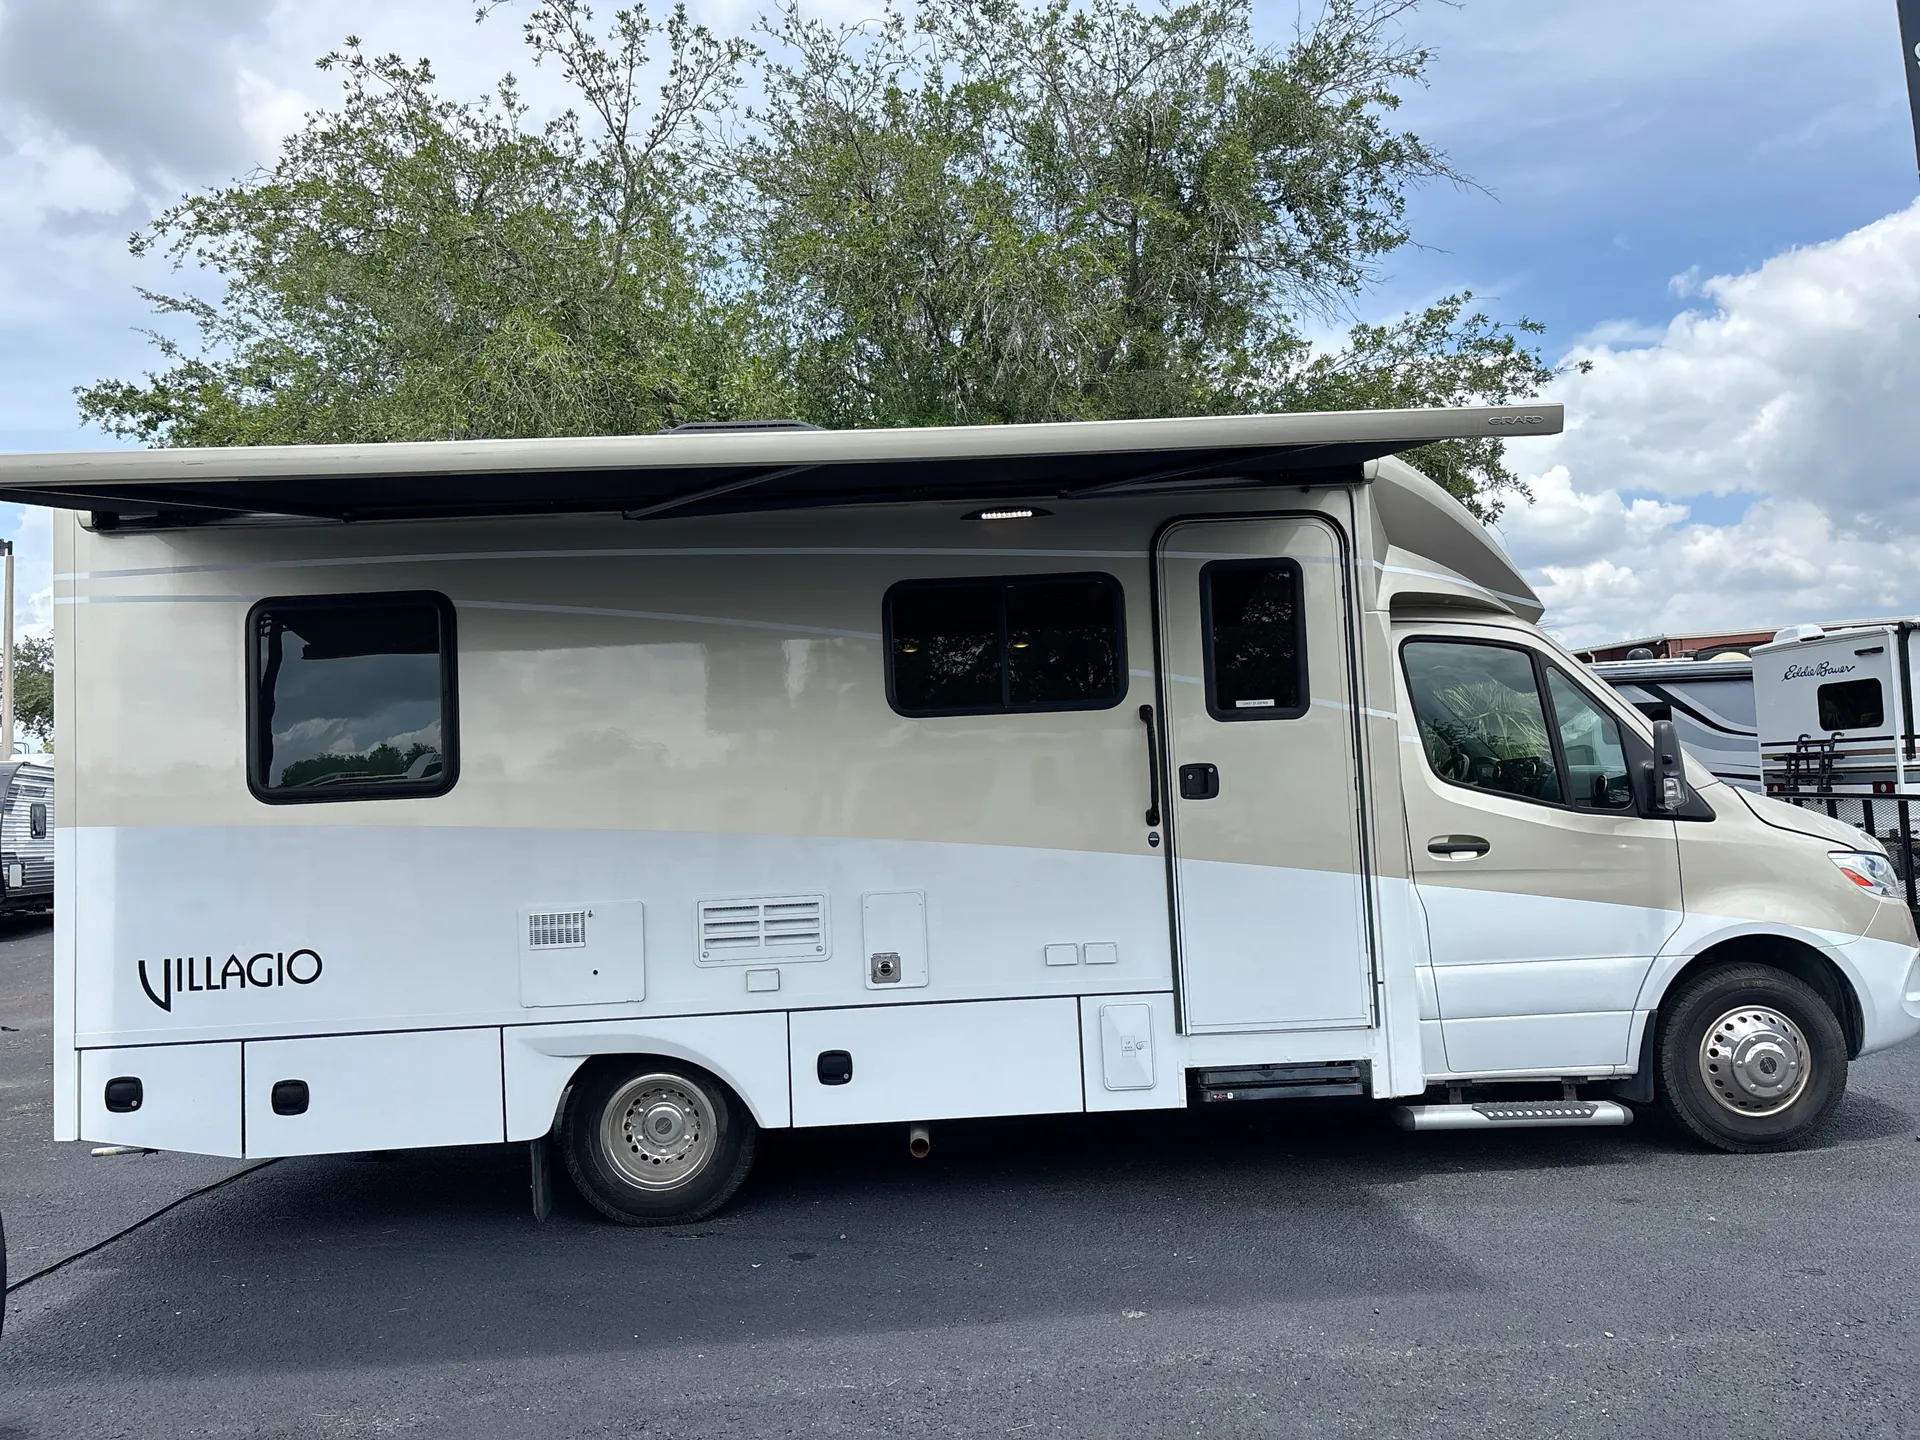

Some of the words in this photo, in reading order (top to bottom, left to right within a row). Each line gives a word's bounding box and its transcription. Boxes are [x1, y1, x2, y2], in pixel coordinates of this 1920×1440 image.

[1781, 664, 1815, 682] Eddie
[1815, 660, 1855, 677] Bauer
[138, 949, 323, 1013] VILLAGIO
